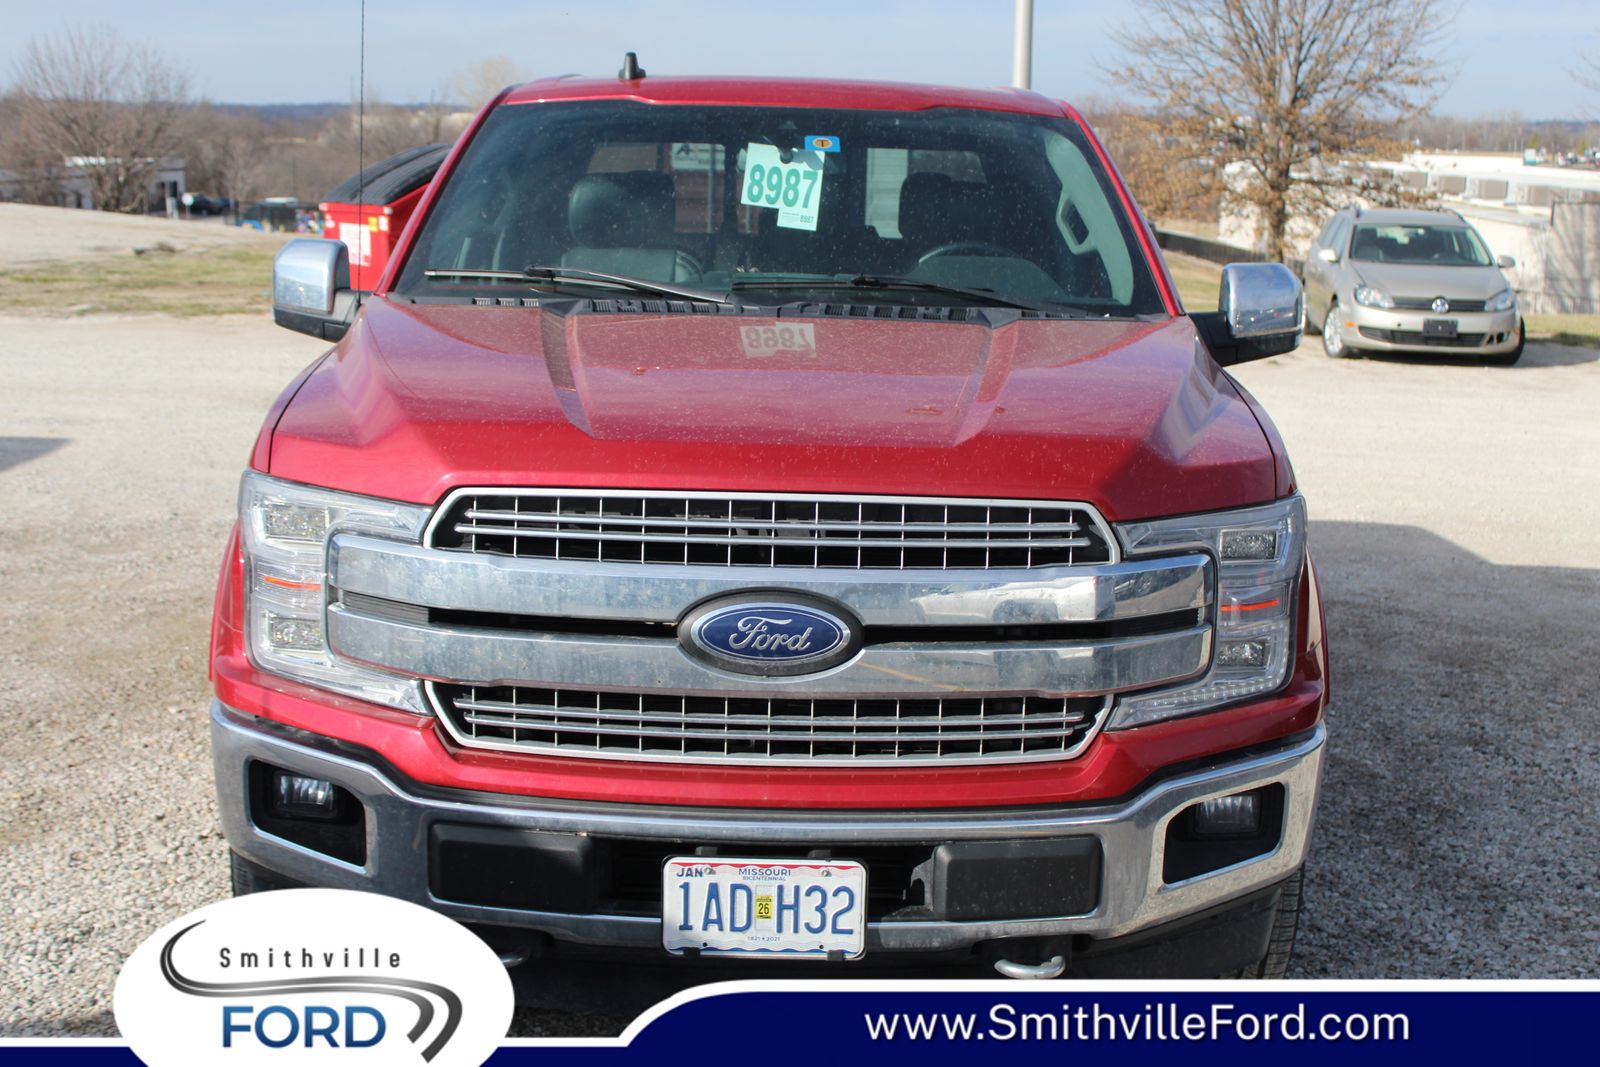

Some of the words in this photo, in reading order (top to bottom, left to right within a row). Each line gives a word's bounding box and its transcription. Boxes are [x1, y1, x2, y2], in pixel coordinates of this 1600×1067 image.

[747, 164, 819, 209] 8987
[728, 616, 813, 650] Ford
[676, 867, 704, 878] JAN
[738, 868, 791, 876] MISSOURI
[678, 881, 753, 932] 1AD
[776, 884, 855, 935] H32
[758, 903, 770, 915] 26
